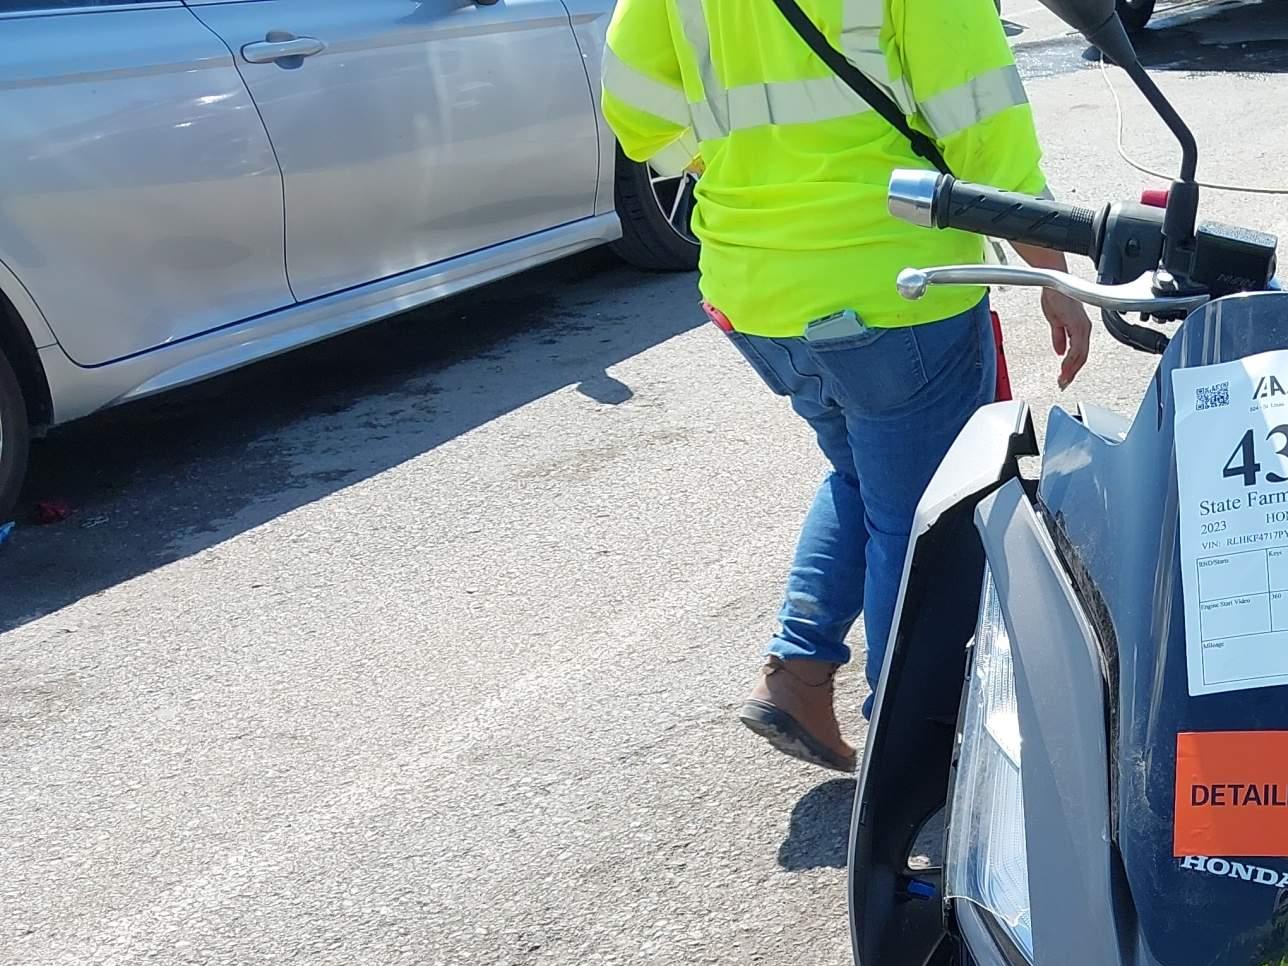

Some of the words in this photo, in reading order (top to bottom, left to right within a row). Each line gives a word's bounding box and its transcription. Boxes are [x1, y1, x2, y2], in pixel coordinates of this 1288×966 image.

[1199, 498, 1241, 517] State
[1200, 520, 1227, 535] 2023
[1201, 540, 1221, 550] VIN:
